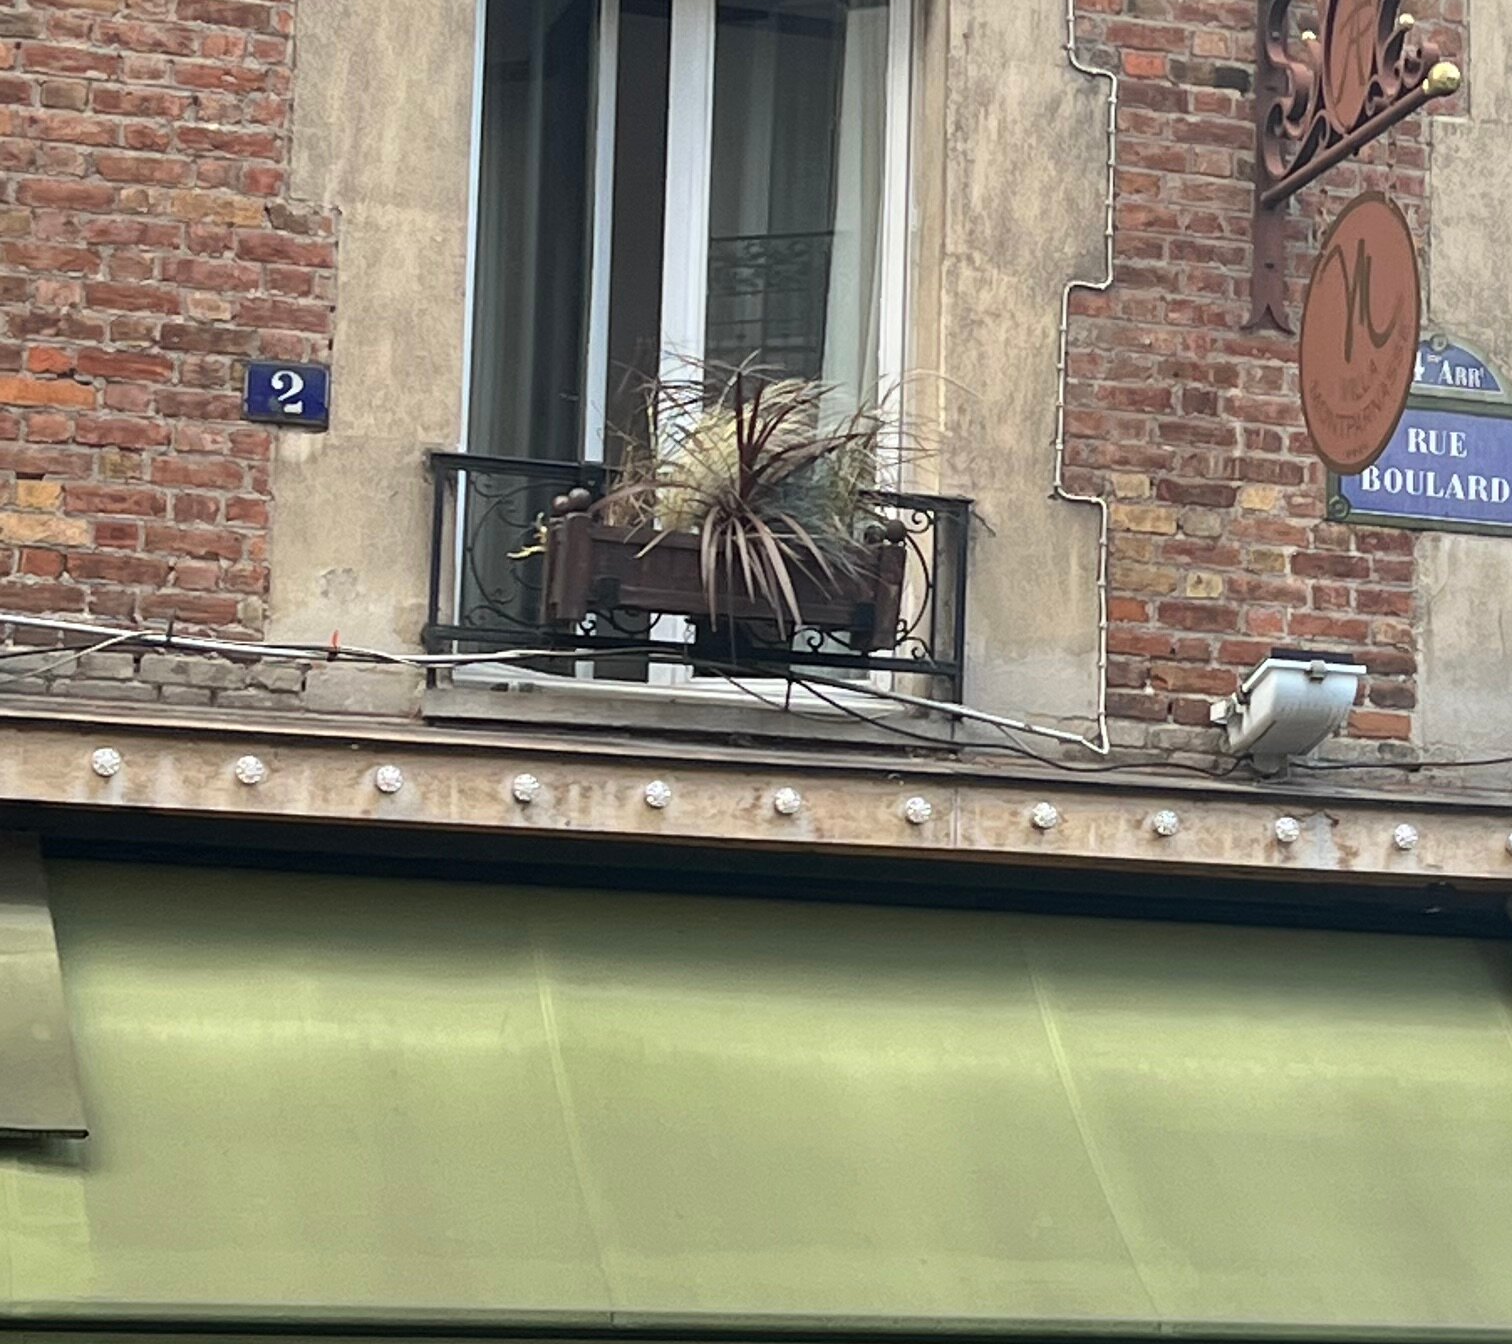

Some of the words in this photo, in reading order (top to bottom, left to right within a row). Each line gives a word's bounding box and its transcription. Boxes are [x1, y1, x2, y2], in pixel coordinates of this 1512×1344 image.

[270, 369, 304, 414] 2
[1407, 426, 1468, 458] RUE
[1360, 465, 1511, 504] BOULARD
